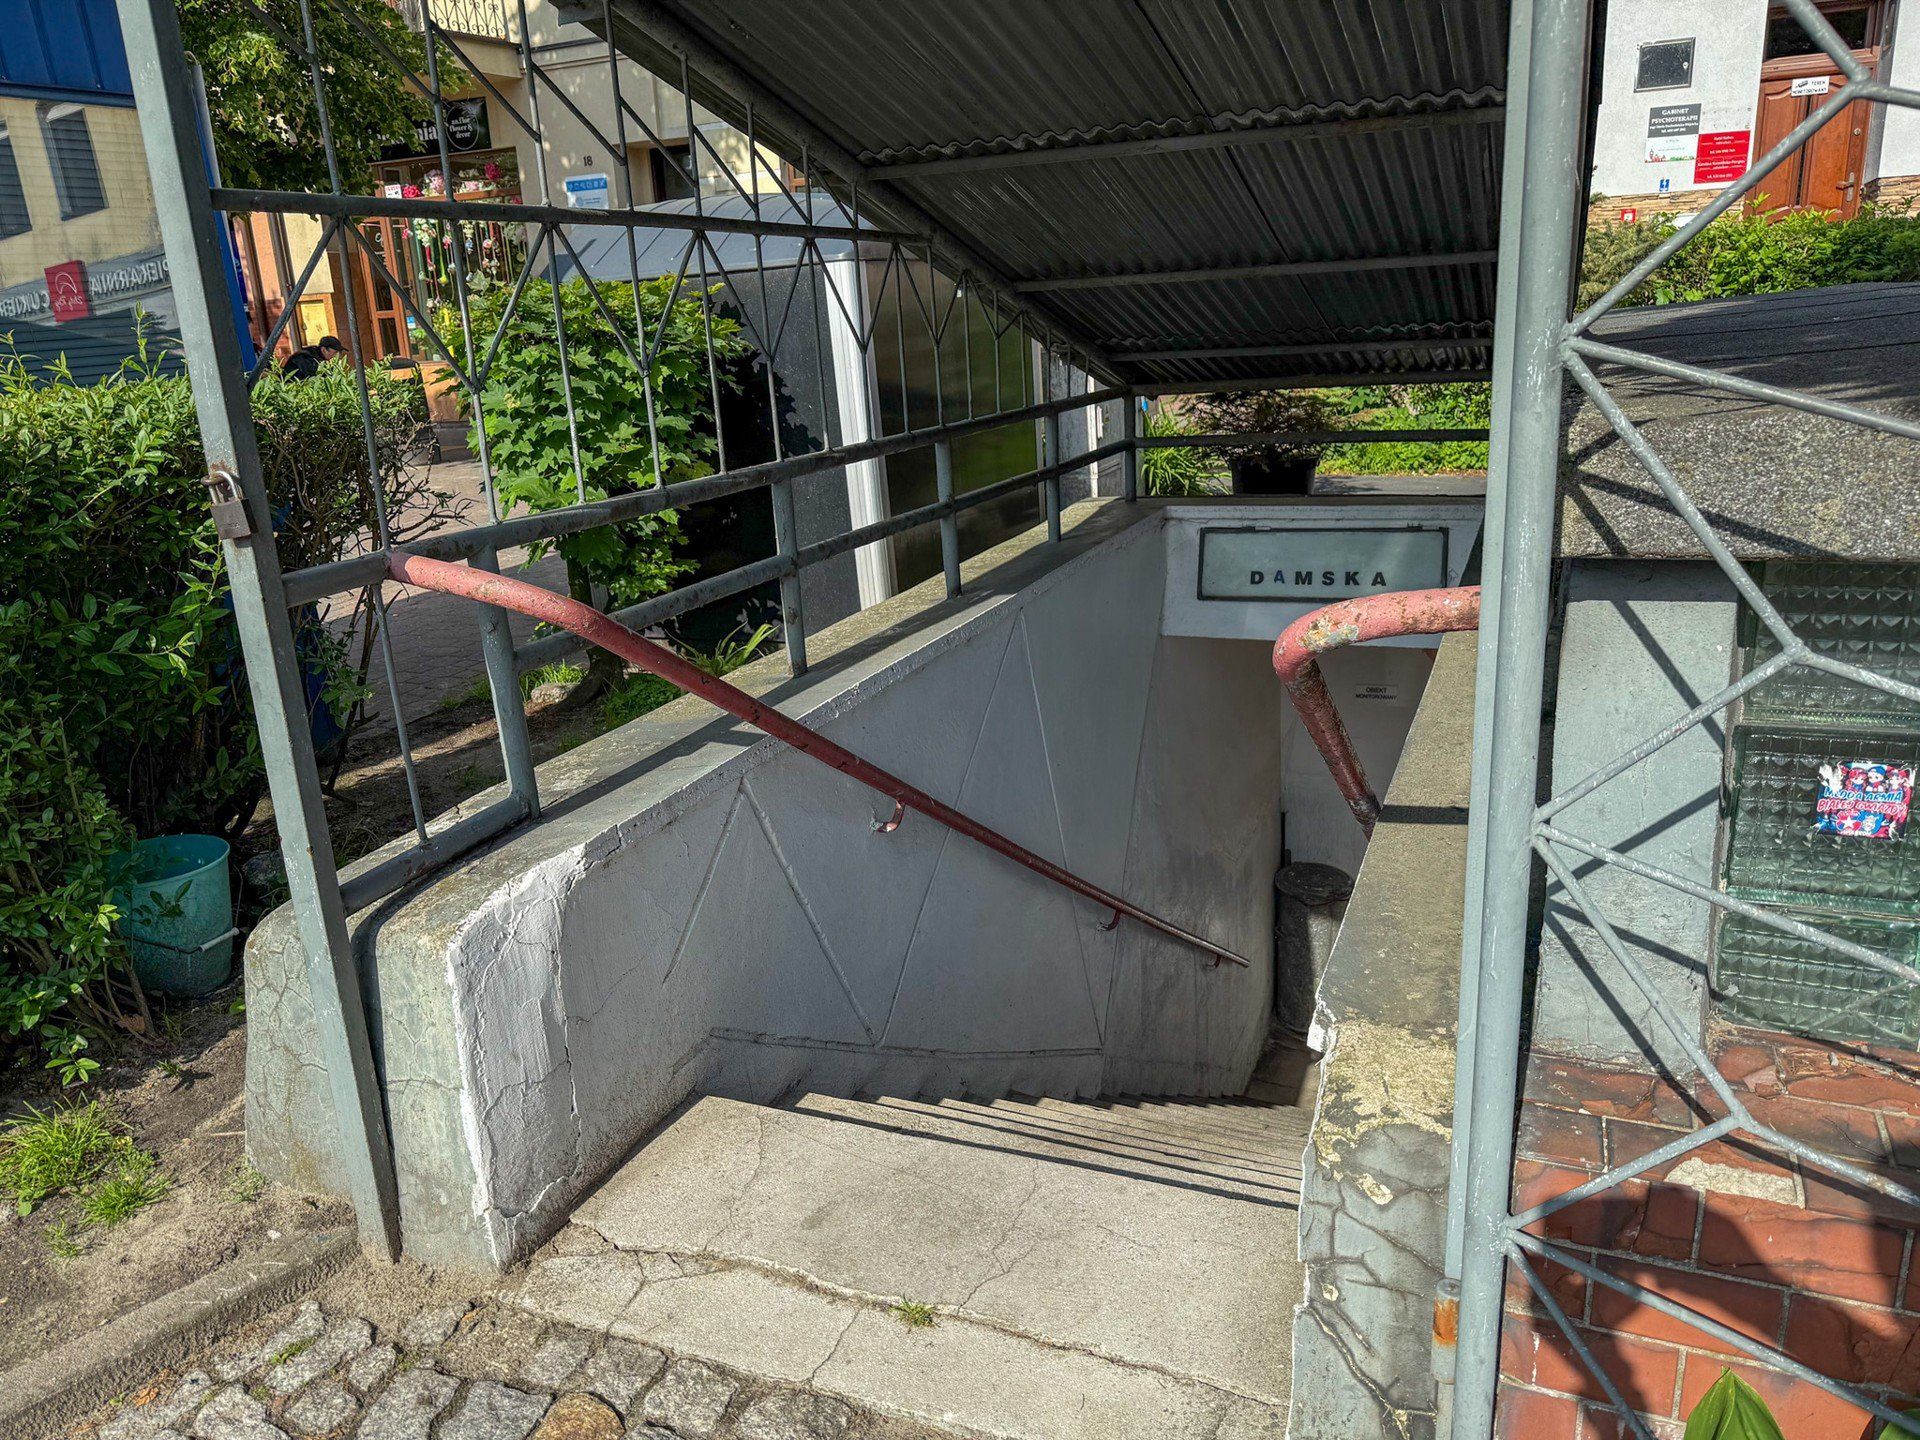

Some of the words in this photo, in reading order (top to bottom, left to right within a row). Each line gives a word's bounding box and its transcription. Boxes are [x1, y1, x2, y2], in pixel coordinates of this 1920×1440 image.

[1661, 107, 1690, 116] GABINET
[1651, 114, 1699, 124] PSYCHOTERAPII
[583, 155, 593, 166] 18
[1250, 570, 1387, 587] DAMSKA
[1365, 686, 1387, 694] OBIEKT
[1863, 790, 1904, 802] ARMIA
